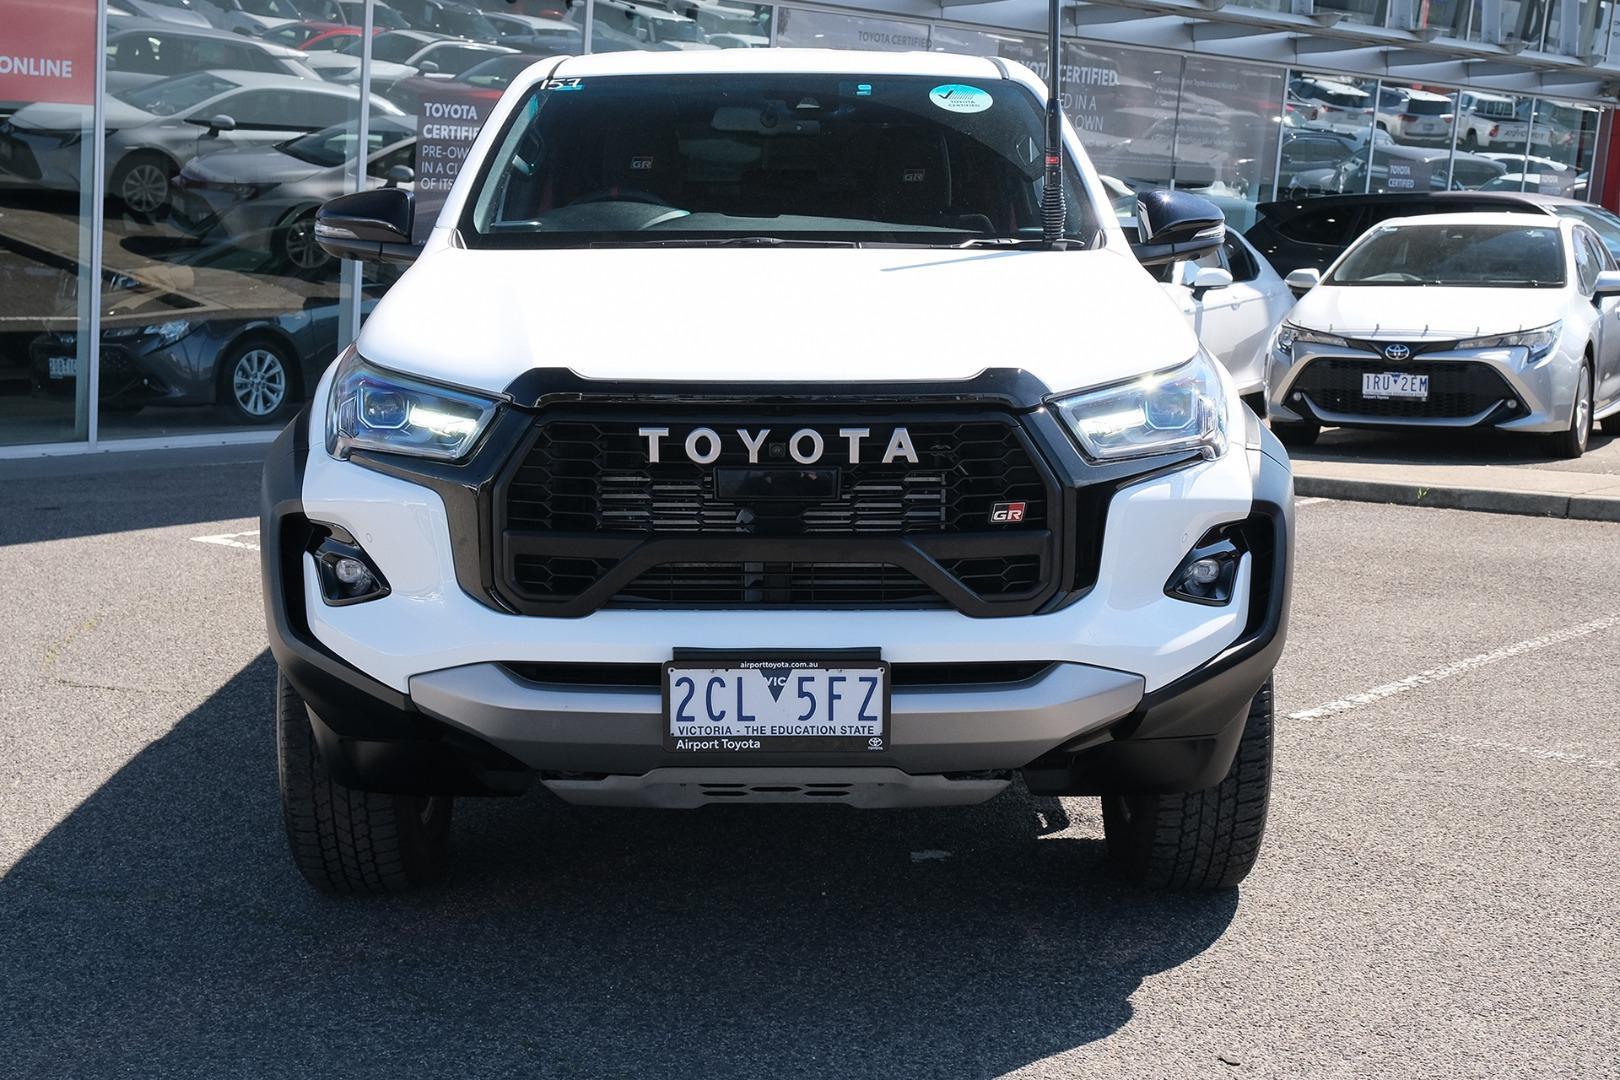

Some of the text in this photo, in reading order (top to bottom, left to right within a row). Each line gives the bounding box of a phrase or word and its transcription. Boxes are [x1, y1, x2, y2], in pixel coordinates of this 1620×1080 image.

[857, 31, 932, 49] TOYOTA CERTIFIED
[0, 56, 72, 78] ONLINE
[1075, 94, 1087, 109] IN
[1089, 95, 1097, 111] A
[424, 102, 478, 120] TOYOTA
[1074, 115, 1104, 131] OWN
[422, 145, 468, 159] PRE-OW
[421, 161, 433, 174] IN
[435, 162, 444, 174] A
[1389, 165, 1410, 175] TOYOTA
[420, 177, 436, 189] OF
[1388, 178, 1415, 188] CERTIFIED
[1366, 375, 1427, 392] 1RU 2EM
[638, 427, 919, 464] TOYOTA
[993, 510, 1022, 520] GR
[740, 661, 818, 669] airporttoyota.com.au
[763, 676, 787, 687] VIC
[675, 676, 878, 722] 2CL 5FZ
[678, 726, 732, 736] VICTORIA
[745, 726, 766, 735] THE
[770, 726, 836, 735] EDUCATION
[840, 726, 874, 735] STATE
[676, 738, 761, 752] Airport Toyota
